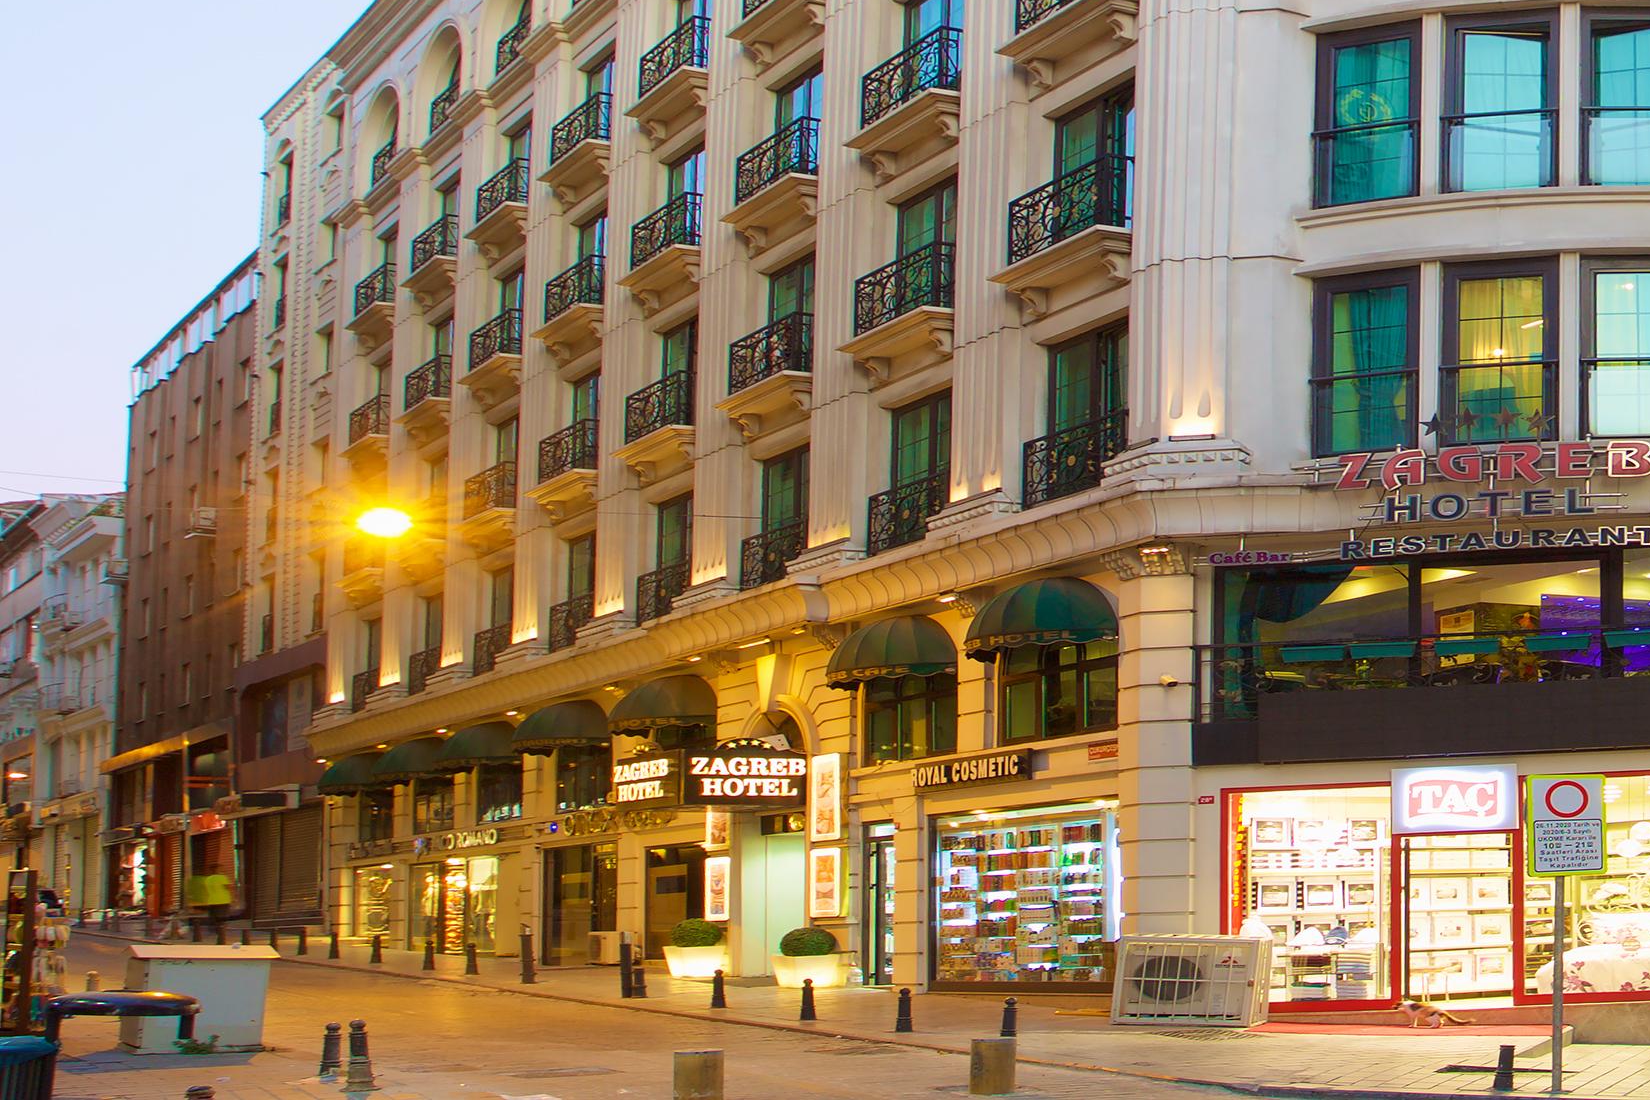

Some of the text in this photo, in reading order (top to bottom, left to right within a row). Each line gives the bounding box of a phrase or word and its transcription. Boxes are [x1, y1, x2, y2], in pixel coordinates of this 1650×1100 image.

[1384, 487, 1598, 523] HOTEL
[1209, 550, 1291, 565] Café Bar
[989, 630, 1077, 646] HOTEL
[852, 666, 910, 677] CAFE
[613, 758, 669, 783] ZAGREB
[690, 757, 807, 777] ZAGREB
[910, 754, 1019, 788] ROYAL COSMETIC
[617, 780, 664, 802] HOTEL
[701, 778, 798, 797] HOTEL
[1411, 783, 1495, 817] TAÇ
